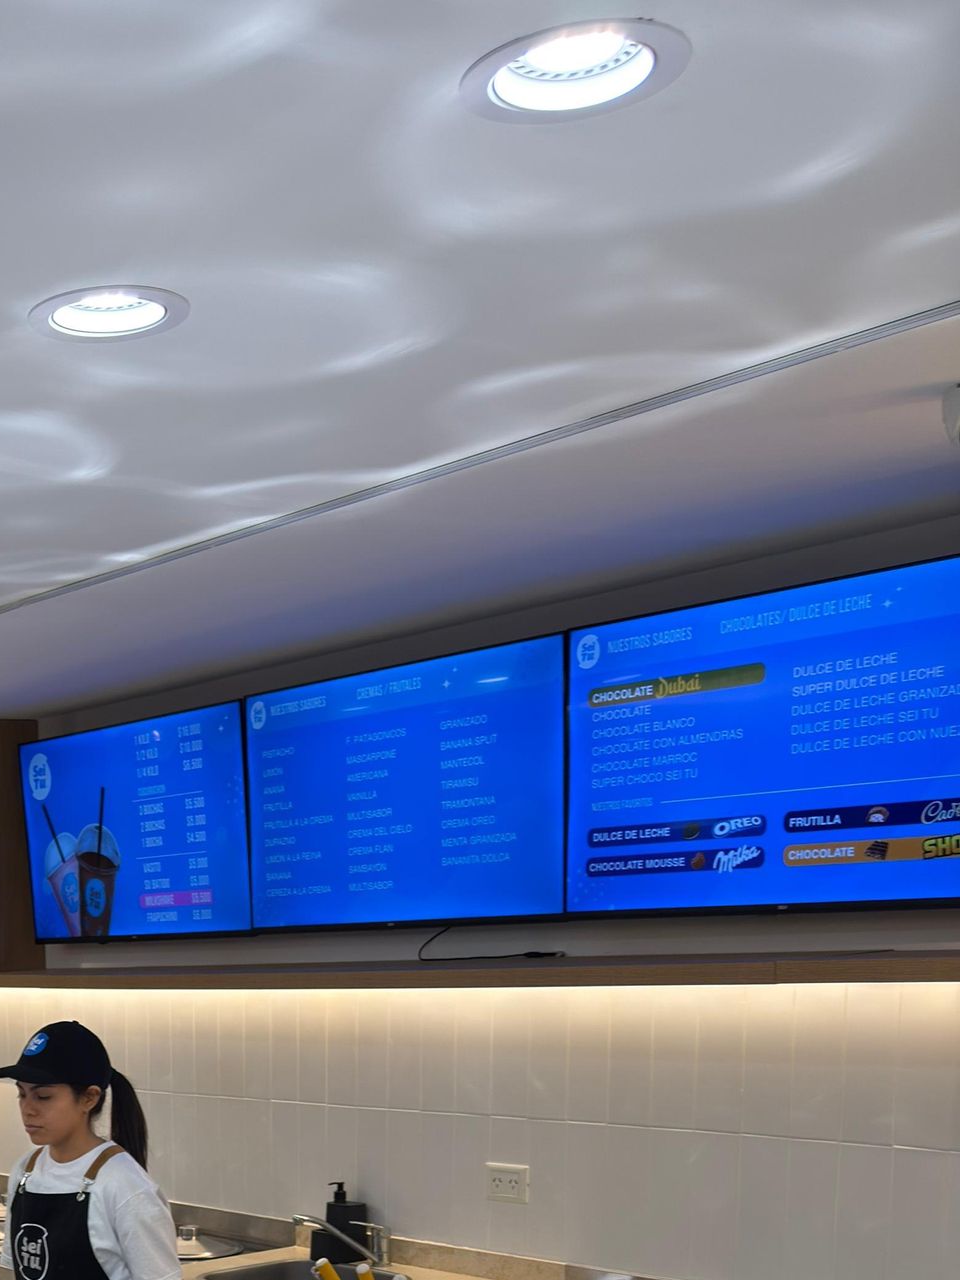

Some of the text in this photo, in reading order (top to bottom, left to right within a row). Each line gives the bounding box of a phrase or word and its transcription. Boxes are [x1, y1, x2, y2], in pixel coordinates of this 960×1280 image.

[789, 603, 822, 622] DULCE
[823, 600, 837, 616] DE
[838, 594, 872, 614] LECHE
[608, 626, 693, 653] NUESTROS SABORES
[793, 652, 898, 678] DULCE DE LECHE
[592, 674, 702, 703] CHOCOLATE Dubai
[792, 666, 945, 697] SUPER DULCE DE LECHE
[592, 705, 652, 721] CHOCOLATE
[791, 701, 831, 716] DULCE
[834, 698, 851, 711] DE
[854, 692, 896, 708] LECHE
[440, 714, 488, 730] GRANIZADO
[592, 717, 695, 739] CHOCOLATE BLANCO
[791, 707, 939, 736] DULCE DE LECHE SEI TU
[440, 734, 497, 751] BANANA SPLIT
[592, 728, 744, 756] CHOCOLATE CON ALMENDRAS
[791, 740, 831, 755] DULCE
[834, 737, 850, 749] DE
[854, 732, 895, 748] LECHE
[898, 728, 926, 743] CON
[440, 756, 485, 770] MANTECOL
[592, 752, 698, 773] CHOCOLATE MARROC
[592, 768, 698, 789] SUPER CHOCO SEI TU
[440, 796, 496, 810] TRAMONTANA
[441, 818, 471, 829] CREMA
[713, 816, 762, 838] OREO
[789, 814, 841, 828] FRUTILLA
[347, 828, 372, 839] CREMA
[441, 837, 468, 848] MENTA
[592, 827, 670, 842] DULCE DE LECHE
[347, 844, 394, 856] CREMA FLAN
[713, 844, 761, 873] Milka
[788, 847, 855, 860] CHOCOLATE
[589, 857, 685, 871] CHOCOLATE MOUSSE
[21, 1236, 42, 1254] Sei
